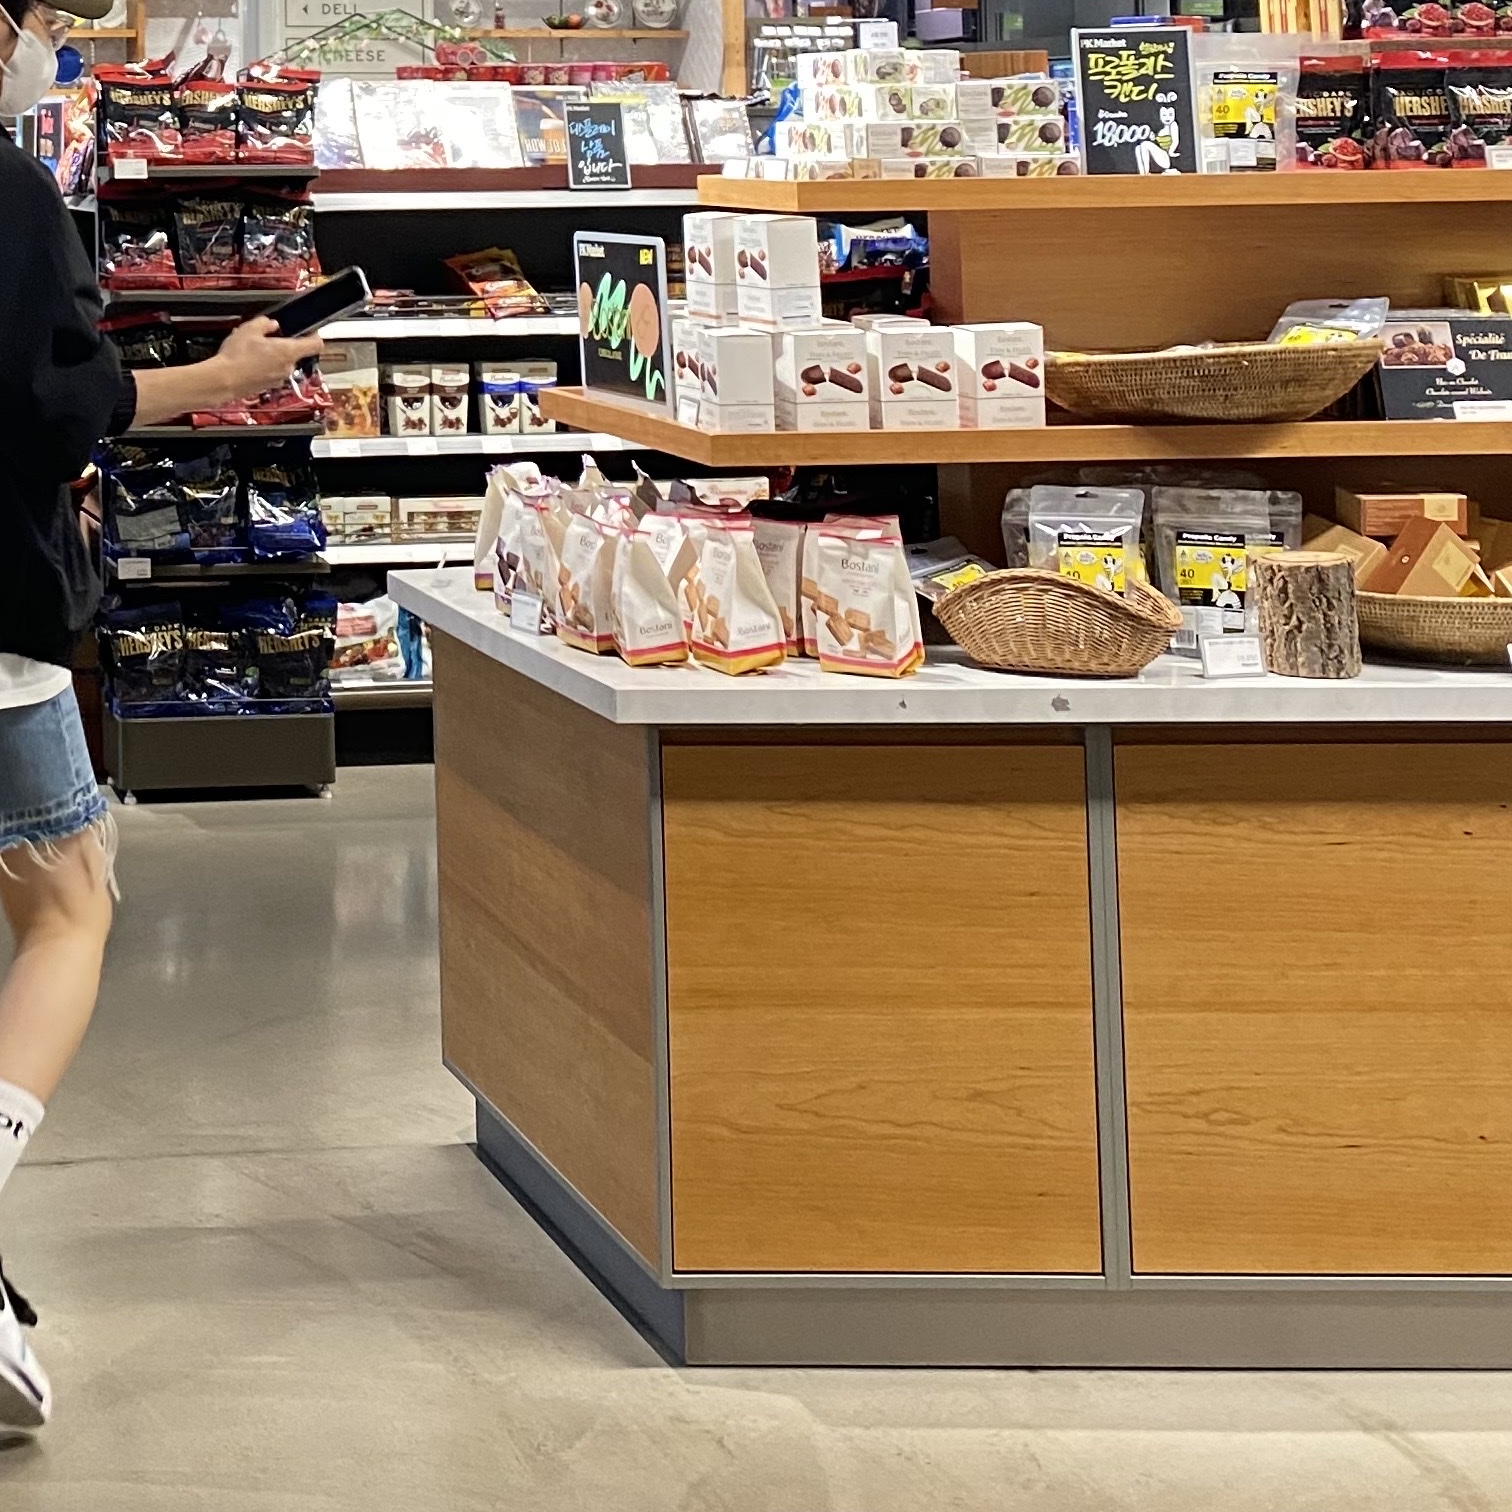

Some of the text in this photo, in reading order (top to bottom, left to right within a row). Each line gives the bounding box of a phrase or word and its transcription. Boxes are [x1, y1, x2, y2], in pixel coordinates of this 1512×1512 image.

[321, 3, 357, 16] DELI
[841, 557, 880, 575] Bostani
[1179, 568, 1195, 579] 40
